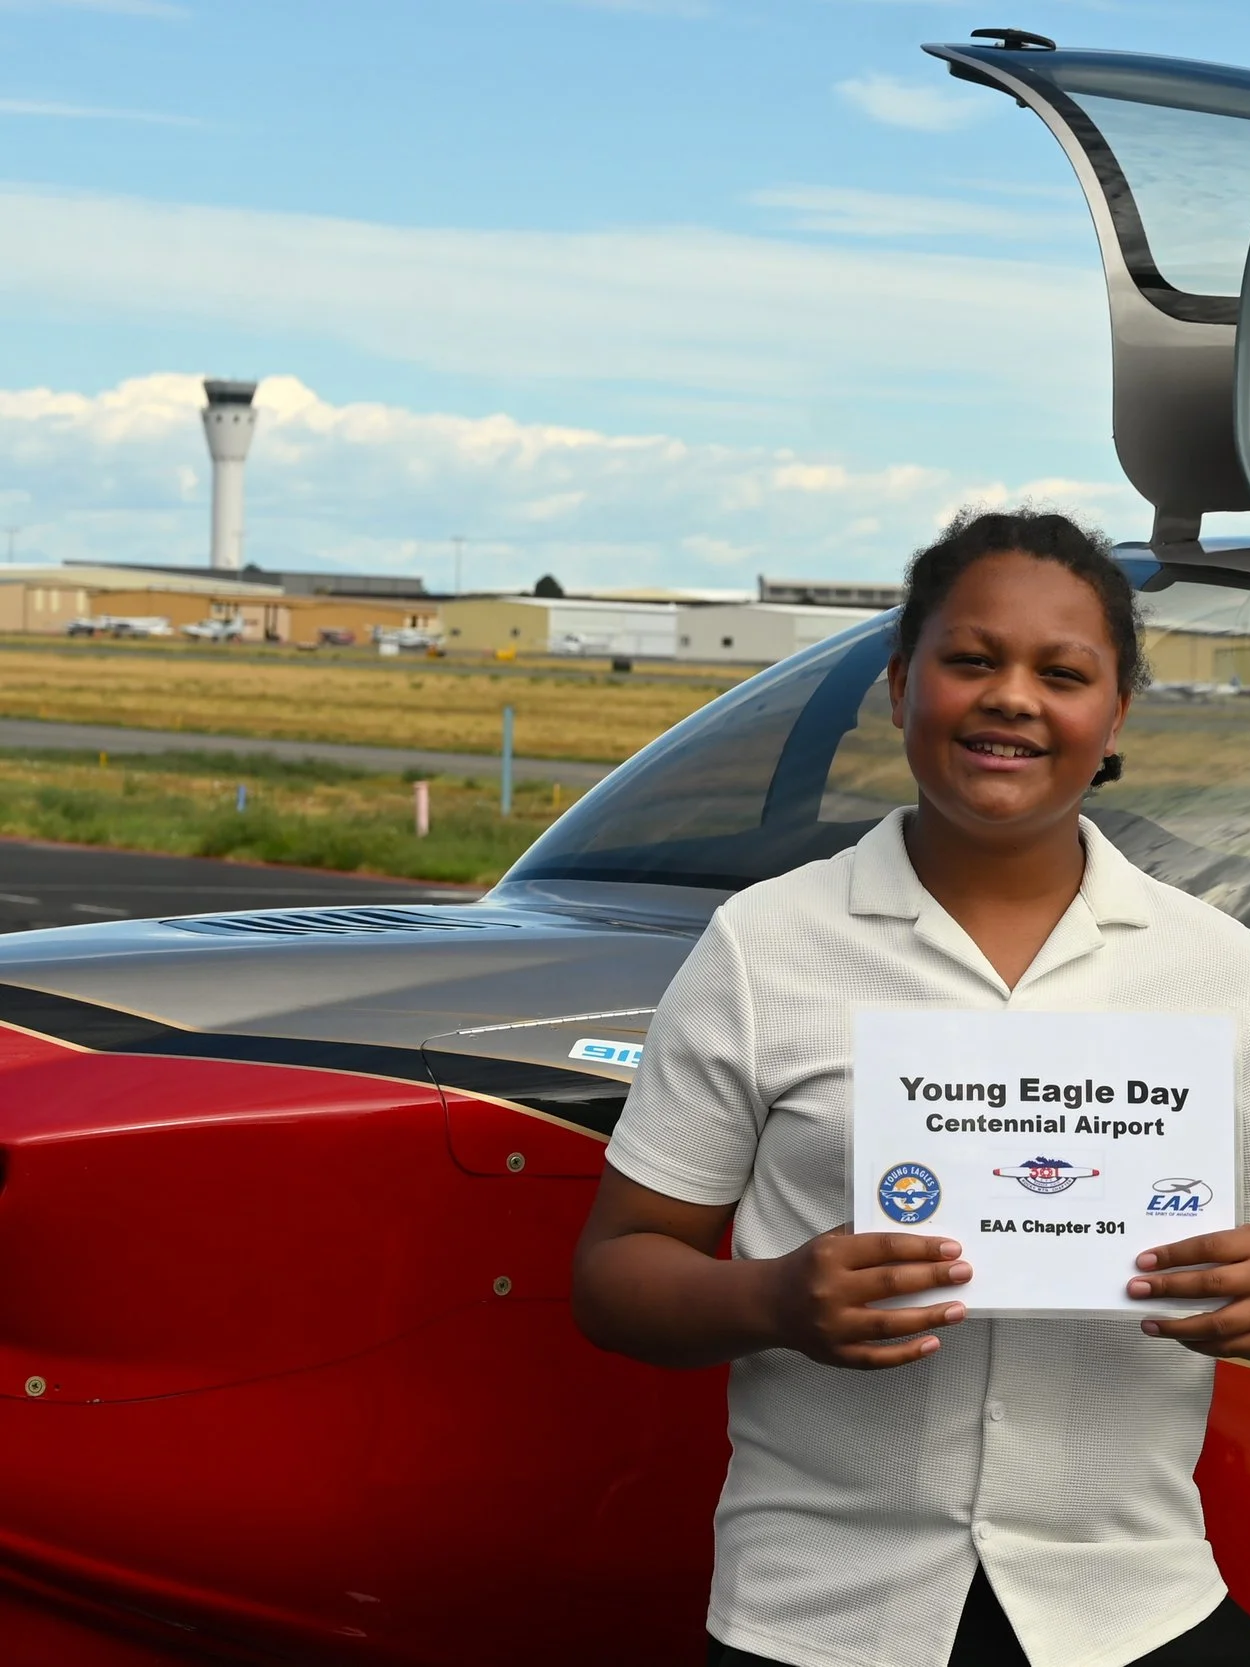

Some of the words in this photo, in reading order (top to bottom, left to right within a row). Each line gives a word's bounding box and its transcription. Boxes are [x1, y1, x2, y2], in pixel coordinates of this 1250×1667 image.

[899, 1076, 1007, 1108] Young
[1019, 1077, 1115, 1110] Eagle
[1127, 1080, 1190, 1112] Day
[925, 1113, 1066, 1134] Centennial
[1074, 1115, 1165, 1139] Airport
[883, 1166, 908, 1187] YOUNG
[910, 1166, 935, 1187] EAGLES
[1146, 1195, 1200, 1211] EAA
[980, 1219, 1017, 1233] EAA
[1022, 1219, 1091, 1236] Chapter
[1095, 1220, 1125, 1234] 301
